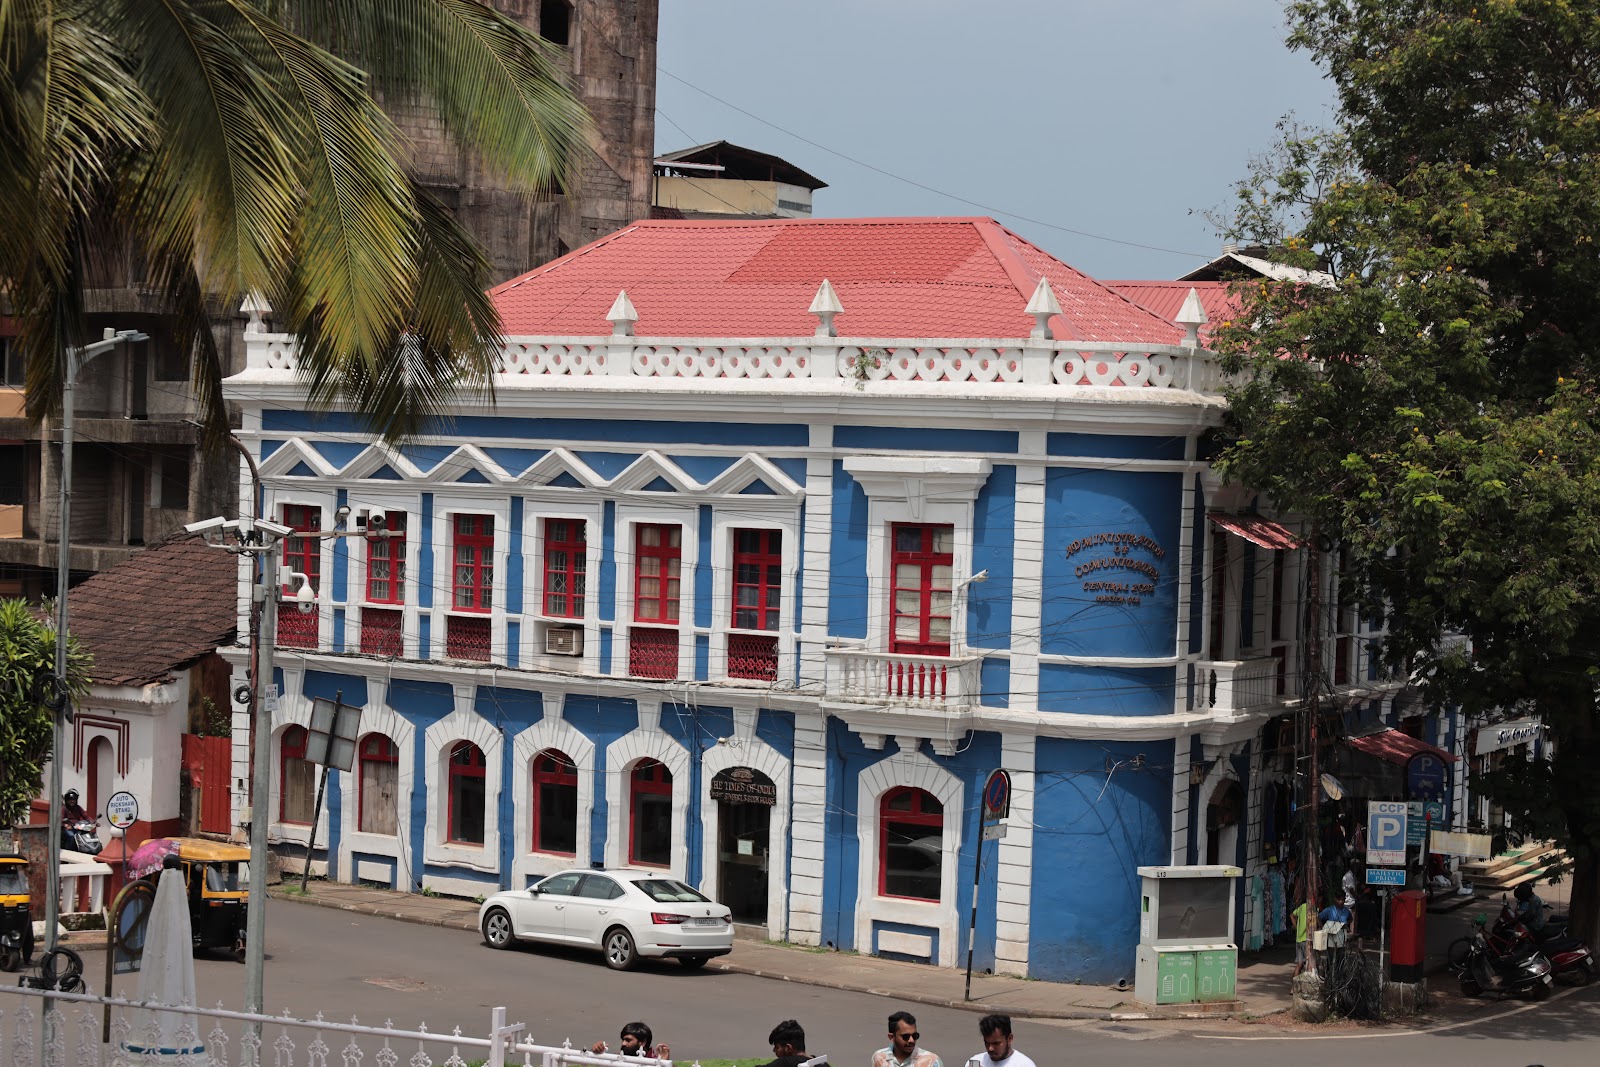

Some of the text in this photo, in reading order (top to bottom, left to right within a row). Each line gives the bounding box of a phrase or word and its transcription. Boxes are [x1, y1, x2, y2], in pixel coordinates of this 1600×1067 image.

[1066, 532, 1165, 558] ADMINISTRATION
[1114, 545, 1129, 554] OF
[1083, 582, 1129, 592] CENTRAL
[1421, 757, 1433, 772] P
[724, 782, 746, 792] TIMES
[757, 784, 776, 796] INDIA
[1378, 803, 1405, 813] CCP
[1377, 817, 1401, 847] P
